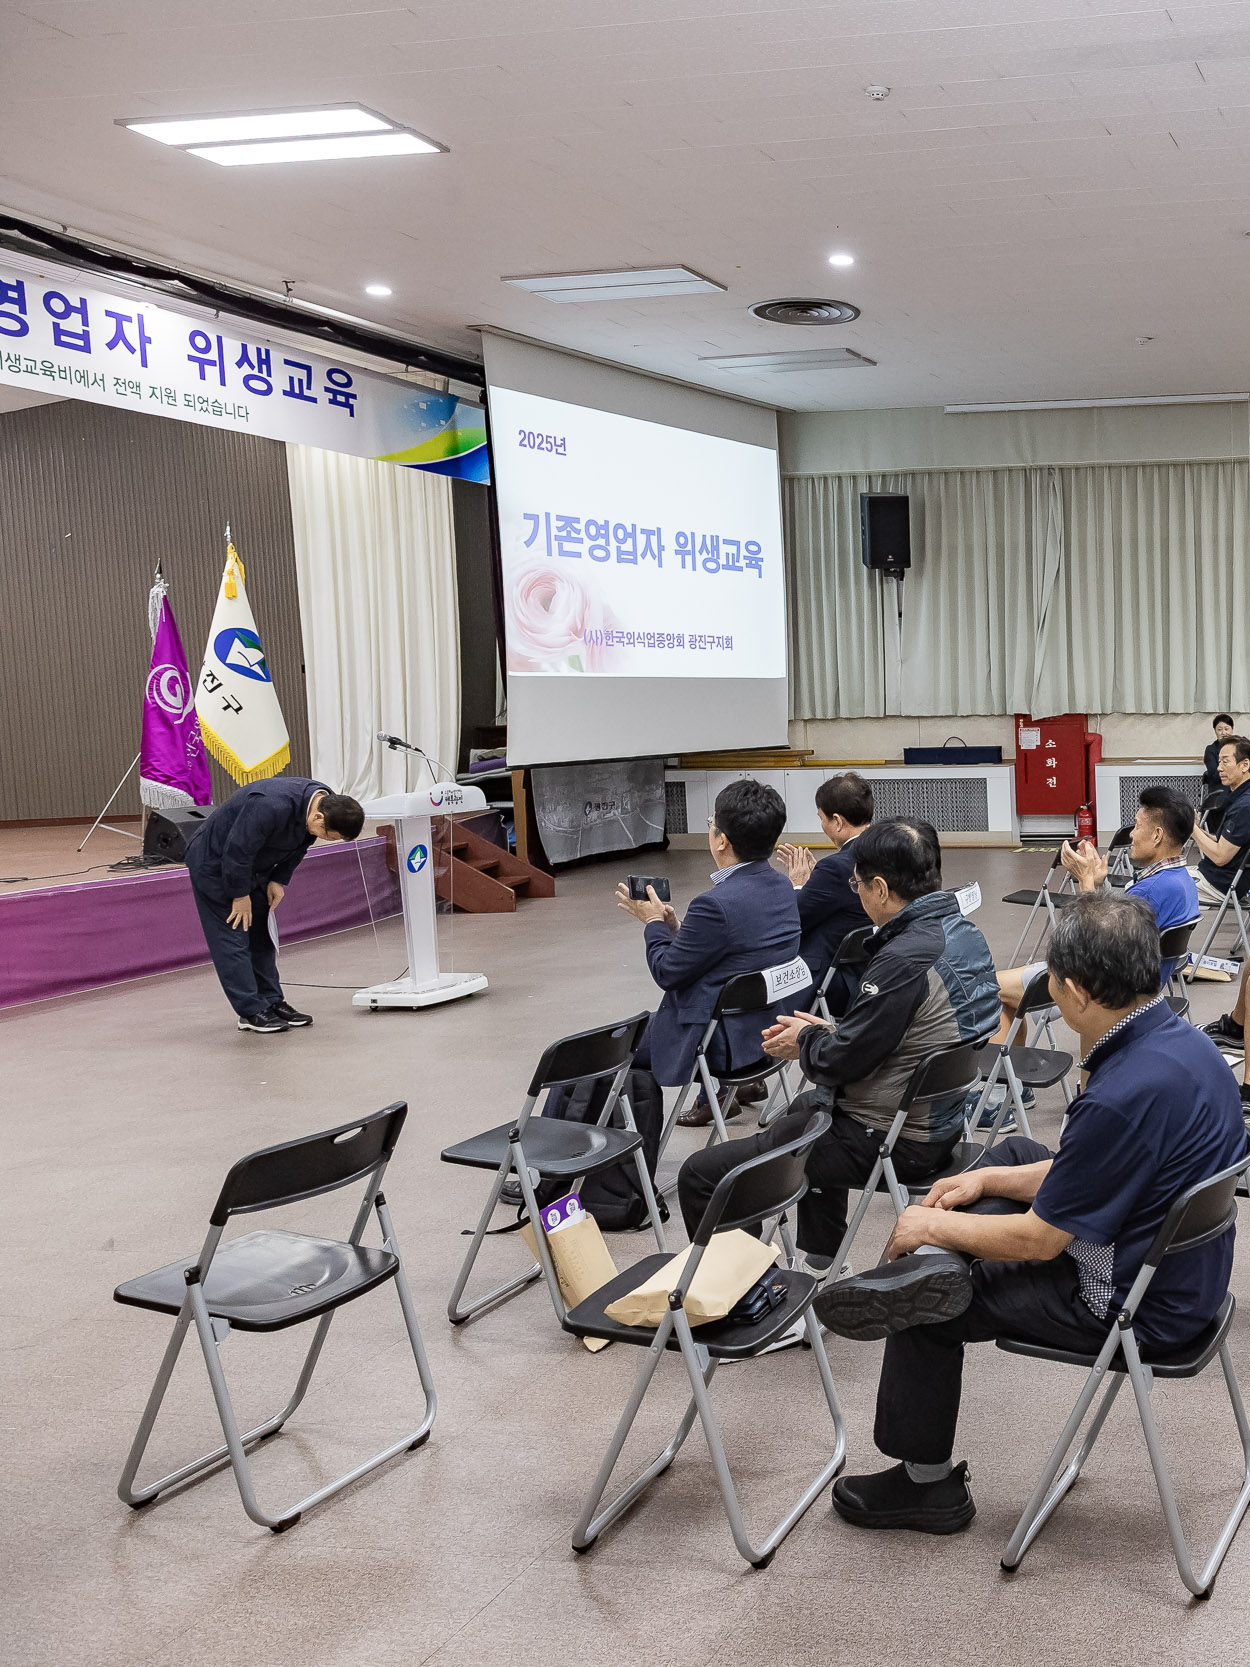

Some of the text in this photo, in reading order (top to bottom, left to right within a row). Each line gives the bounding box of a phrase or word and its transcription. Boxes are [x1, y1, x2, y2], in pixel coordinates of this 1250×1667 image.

[0, 353, 249, 423] 생교육비에서 전액 지원 되었습니다
[187, 329, 358, 418] 위생교육
[518, 429, 567, 456] 2025년
[523, 511, 764, 579] 기존영업자 위생교육
[583, 628, 734, 651] (사)한국외식업중앙회 광진구지회
[203, 667, 243, 715] 진구
[1045, 739, 1058, 788] 소화전
[775, 965, 806, 987] 보건소장님
